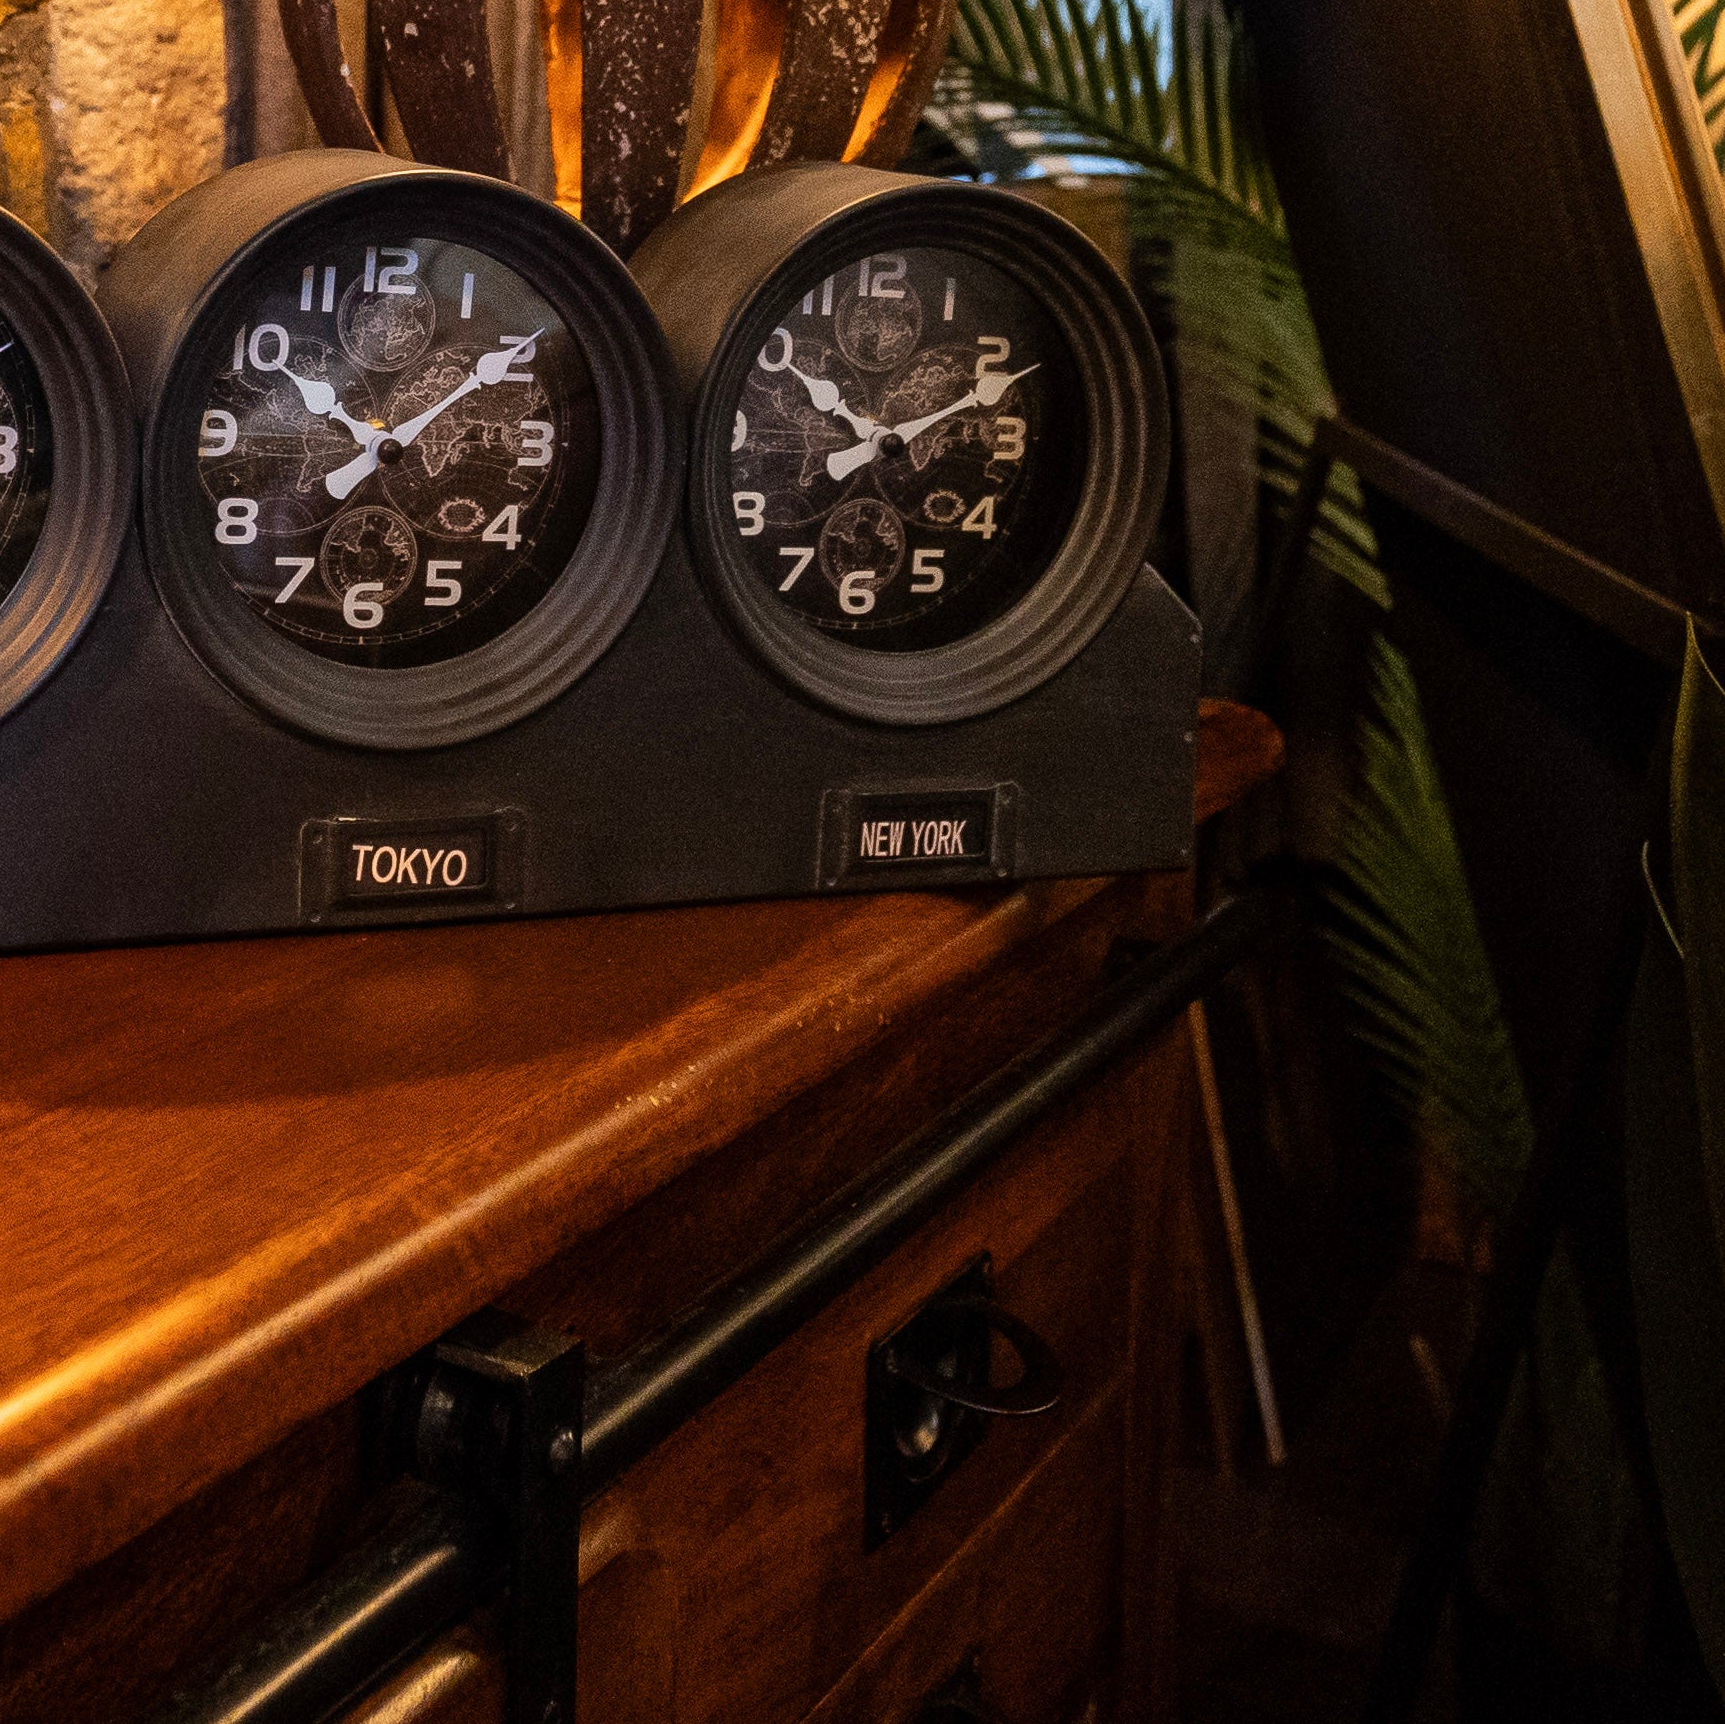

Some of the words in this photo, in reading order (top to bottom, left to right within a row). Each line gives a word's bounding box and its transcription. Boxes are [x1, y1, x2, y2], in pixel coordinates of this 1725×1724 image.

[300, 266, 336, 312] 11
[363, 247, 419, 295] 12
[859, 254, 907, 298] 12
[461, 273, 474, 318] 1
[944, 278, 956, 321] 1
[233, 324, 290, 371] 10
[977, 337, 1010, 378] 2
[198, 410, 238, 456] 9
[518, 421, 554, 466] 3
[994, 417, 1026, 460] 3
[215, 499, 259, 544] 8
[482, 505, 521, 549] 4
[962, 496, 997, 539] 4
[275, 557, 315, 604] 7
[424, 561, 462, 605] 5
[779, 547, 814, 591] 7
[910, 550, 945, 593] 5
[343, 582, 385, 629] 6
[839, 571, 876, 614] 6
[860, 821, 905, 857] NEW
[912, 820, 966, 856] YORK
[352, 844, 467, 886] TOKYO
